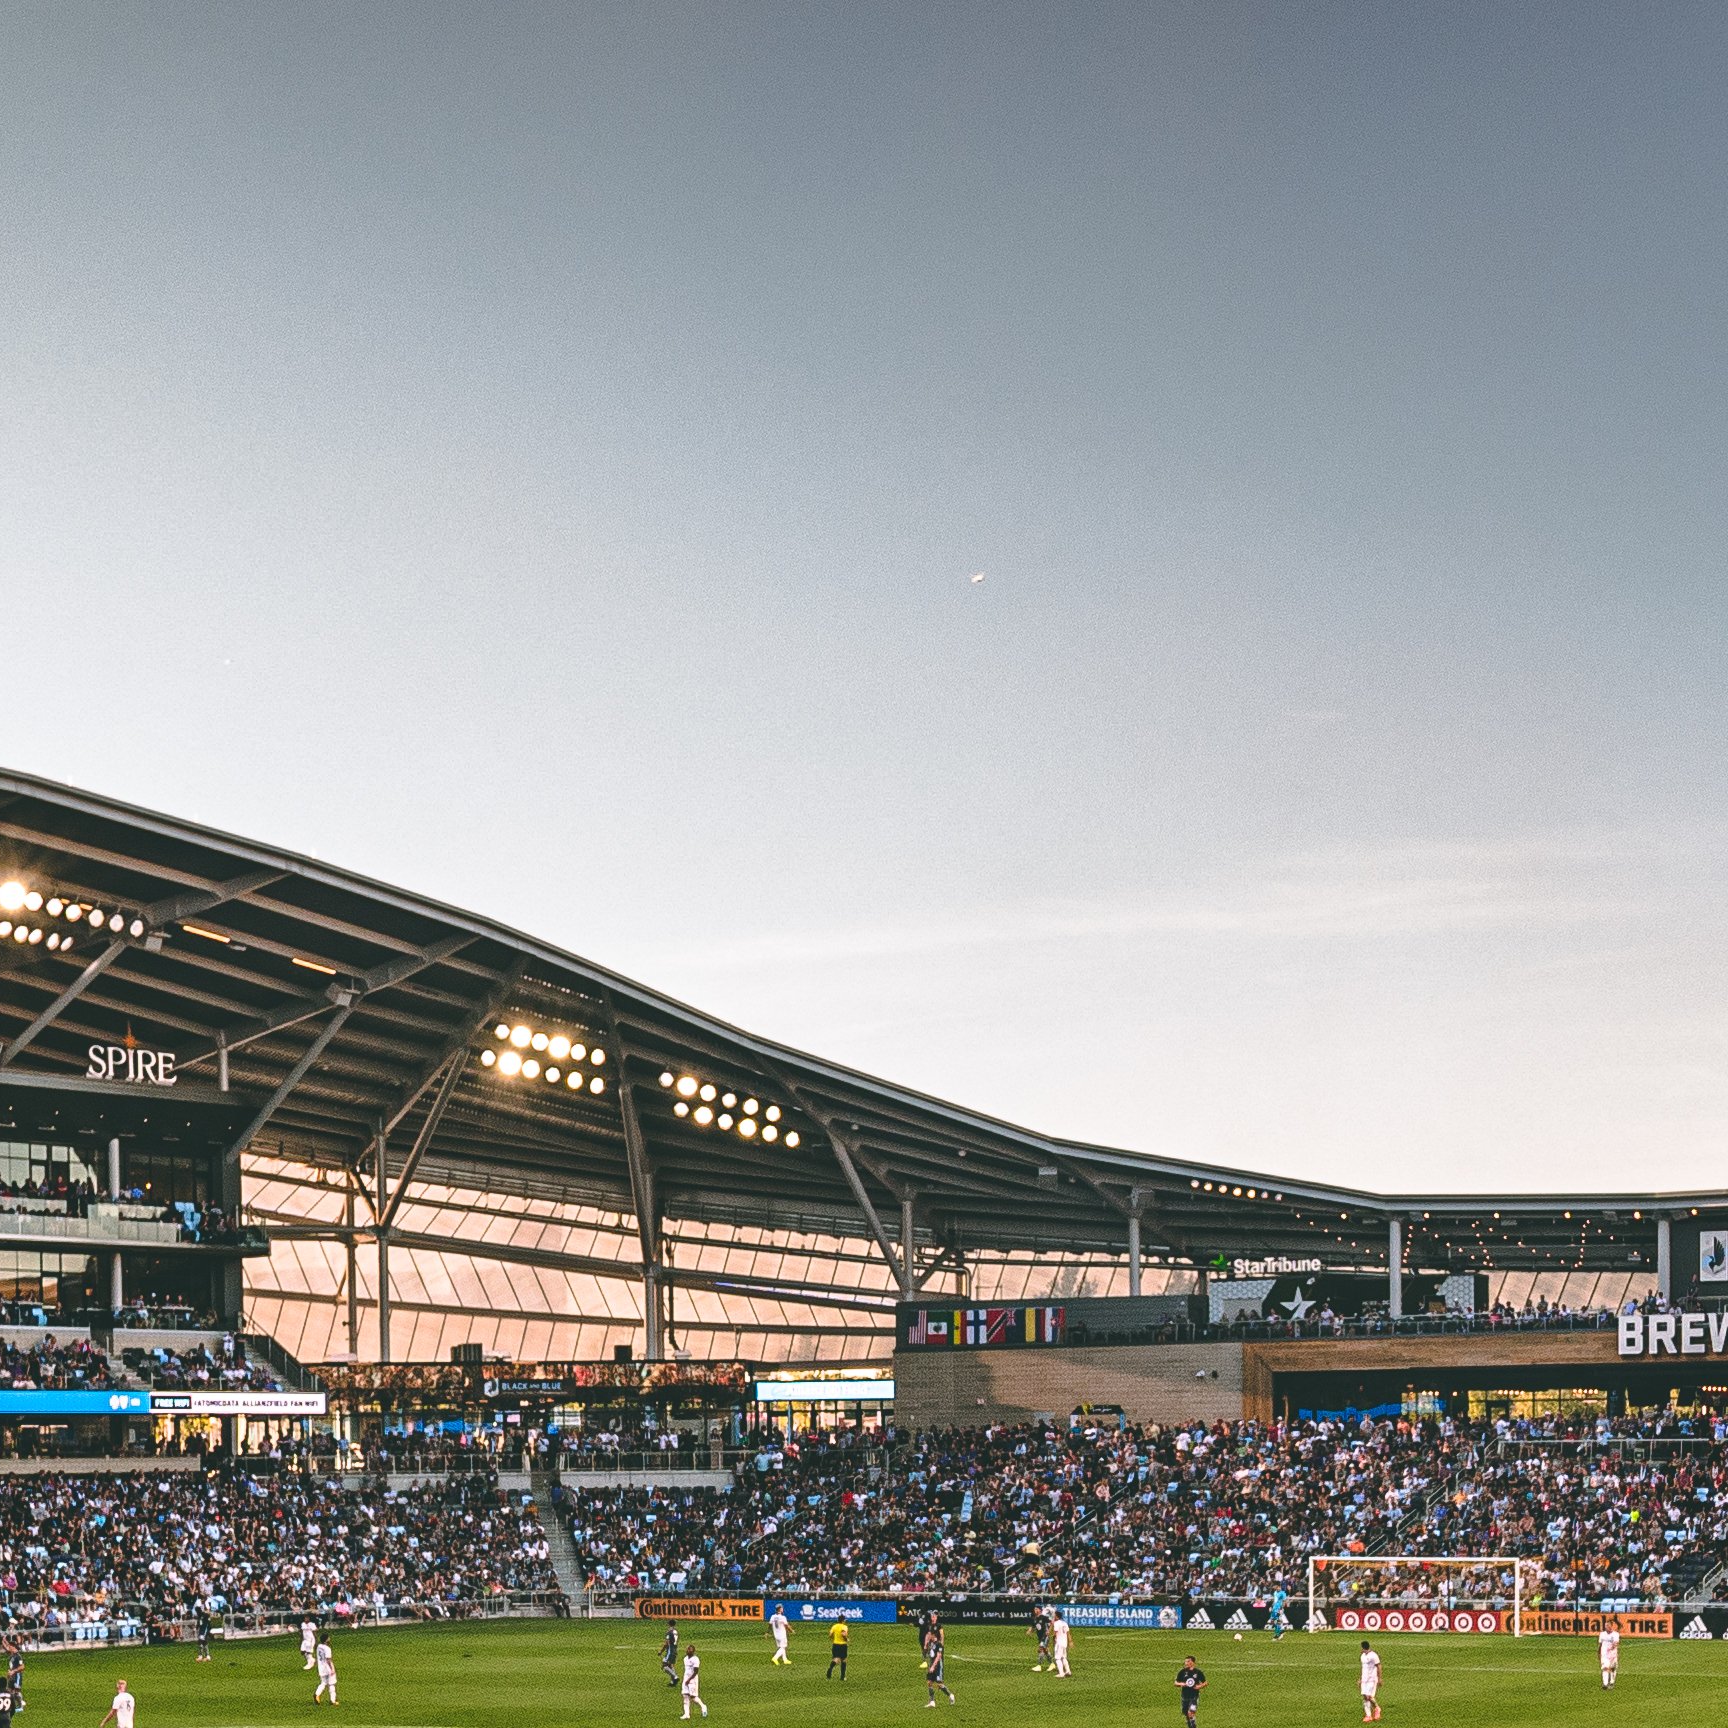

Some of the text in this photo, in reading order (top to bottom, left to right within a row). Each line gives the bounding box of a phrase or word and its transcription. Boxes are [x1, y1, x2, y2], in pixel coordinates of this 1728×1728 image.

[85, 1044, 178, 1084] SPIRE
[1233, 1257, 1322, 1274] StarTribune
[541, 1382, 561, 1390] BLUE
[639, 1599, 761, 1619] Continental TIRE
[817, 1607, 864, 1619] SeatGeek
[1062, 1607, 1153, 1619] TREASURE ISLAND
[1627, 1619, 1668, 1633] TIRE
[1679, 1631, 1712, 1639] adidas
